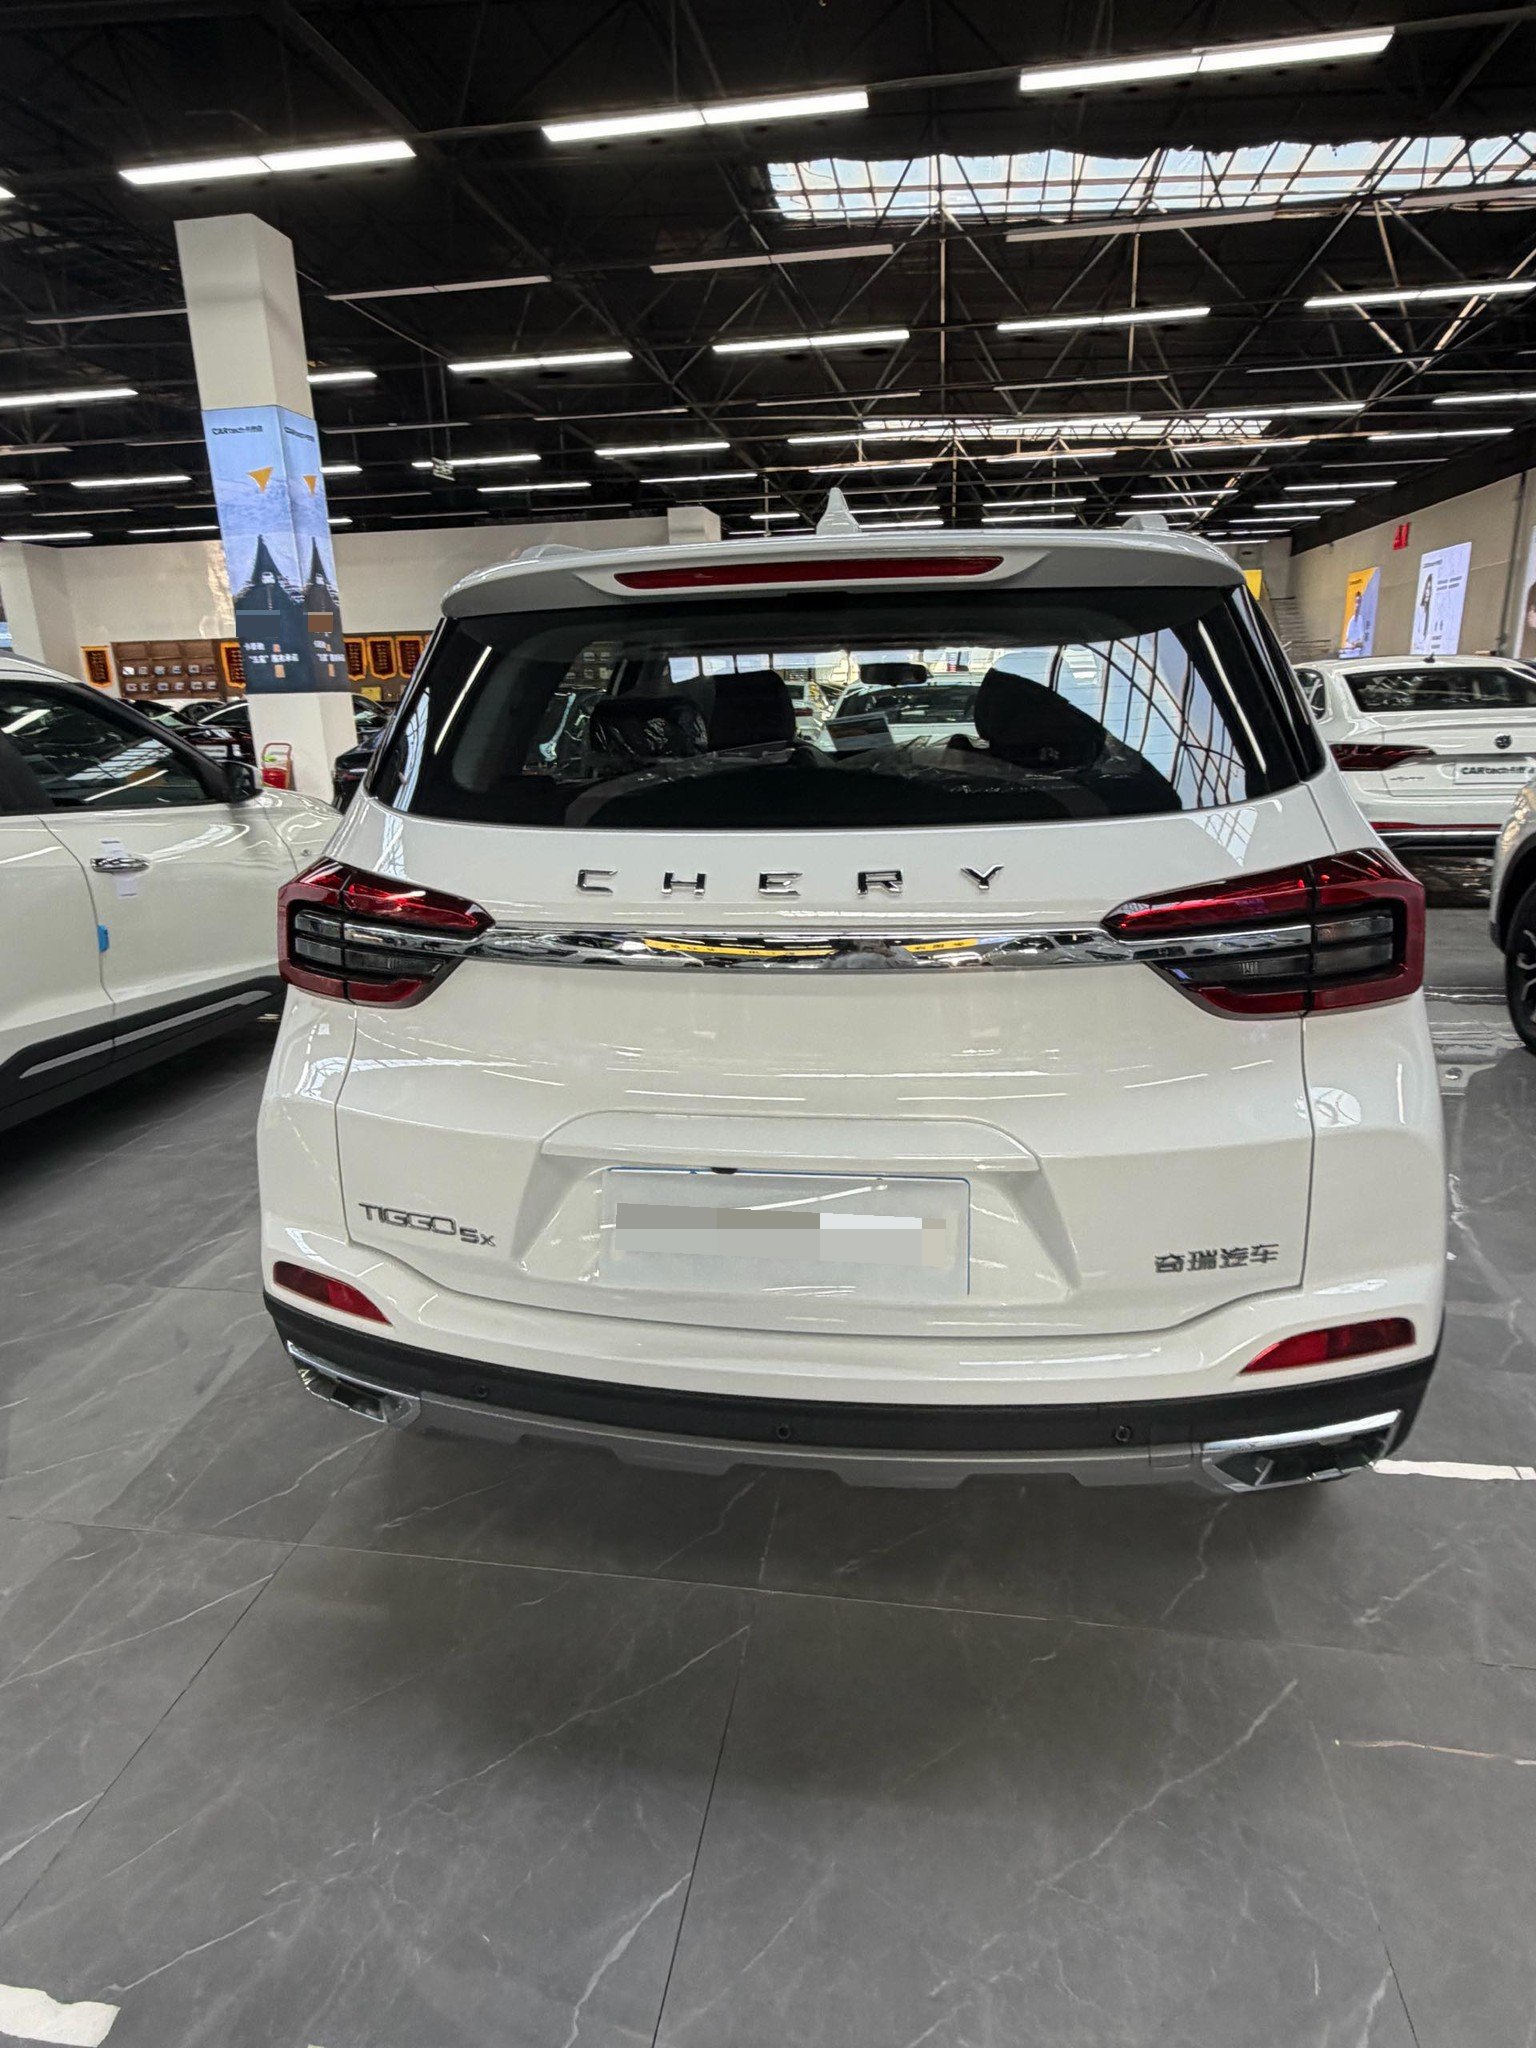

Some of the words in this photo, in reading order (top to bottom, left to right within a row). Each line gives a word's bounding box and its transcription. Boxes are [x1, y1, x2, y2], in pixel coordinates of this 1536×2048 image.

[575, 865, 1005, 896] CHERY
[358, 1202, 457, 1236] TIGGO
[1154, 1243, 1279, 1273] 奇瑞汽车
